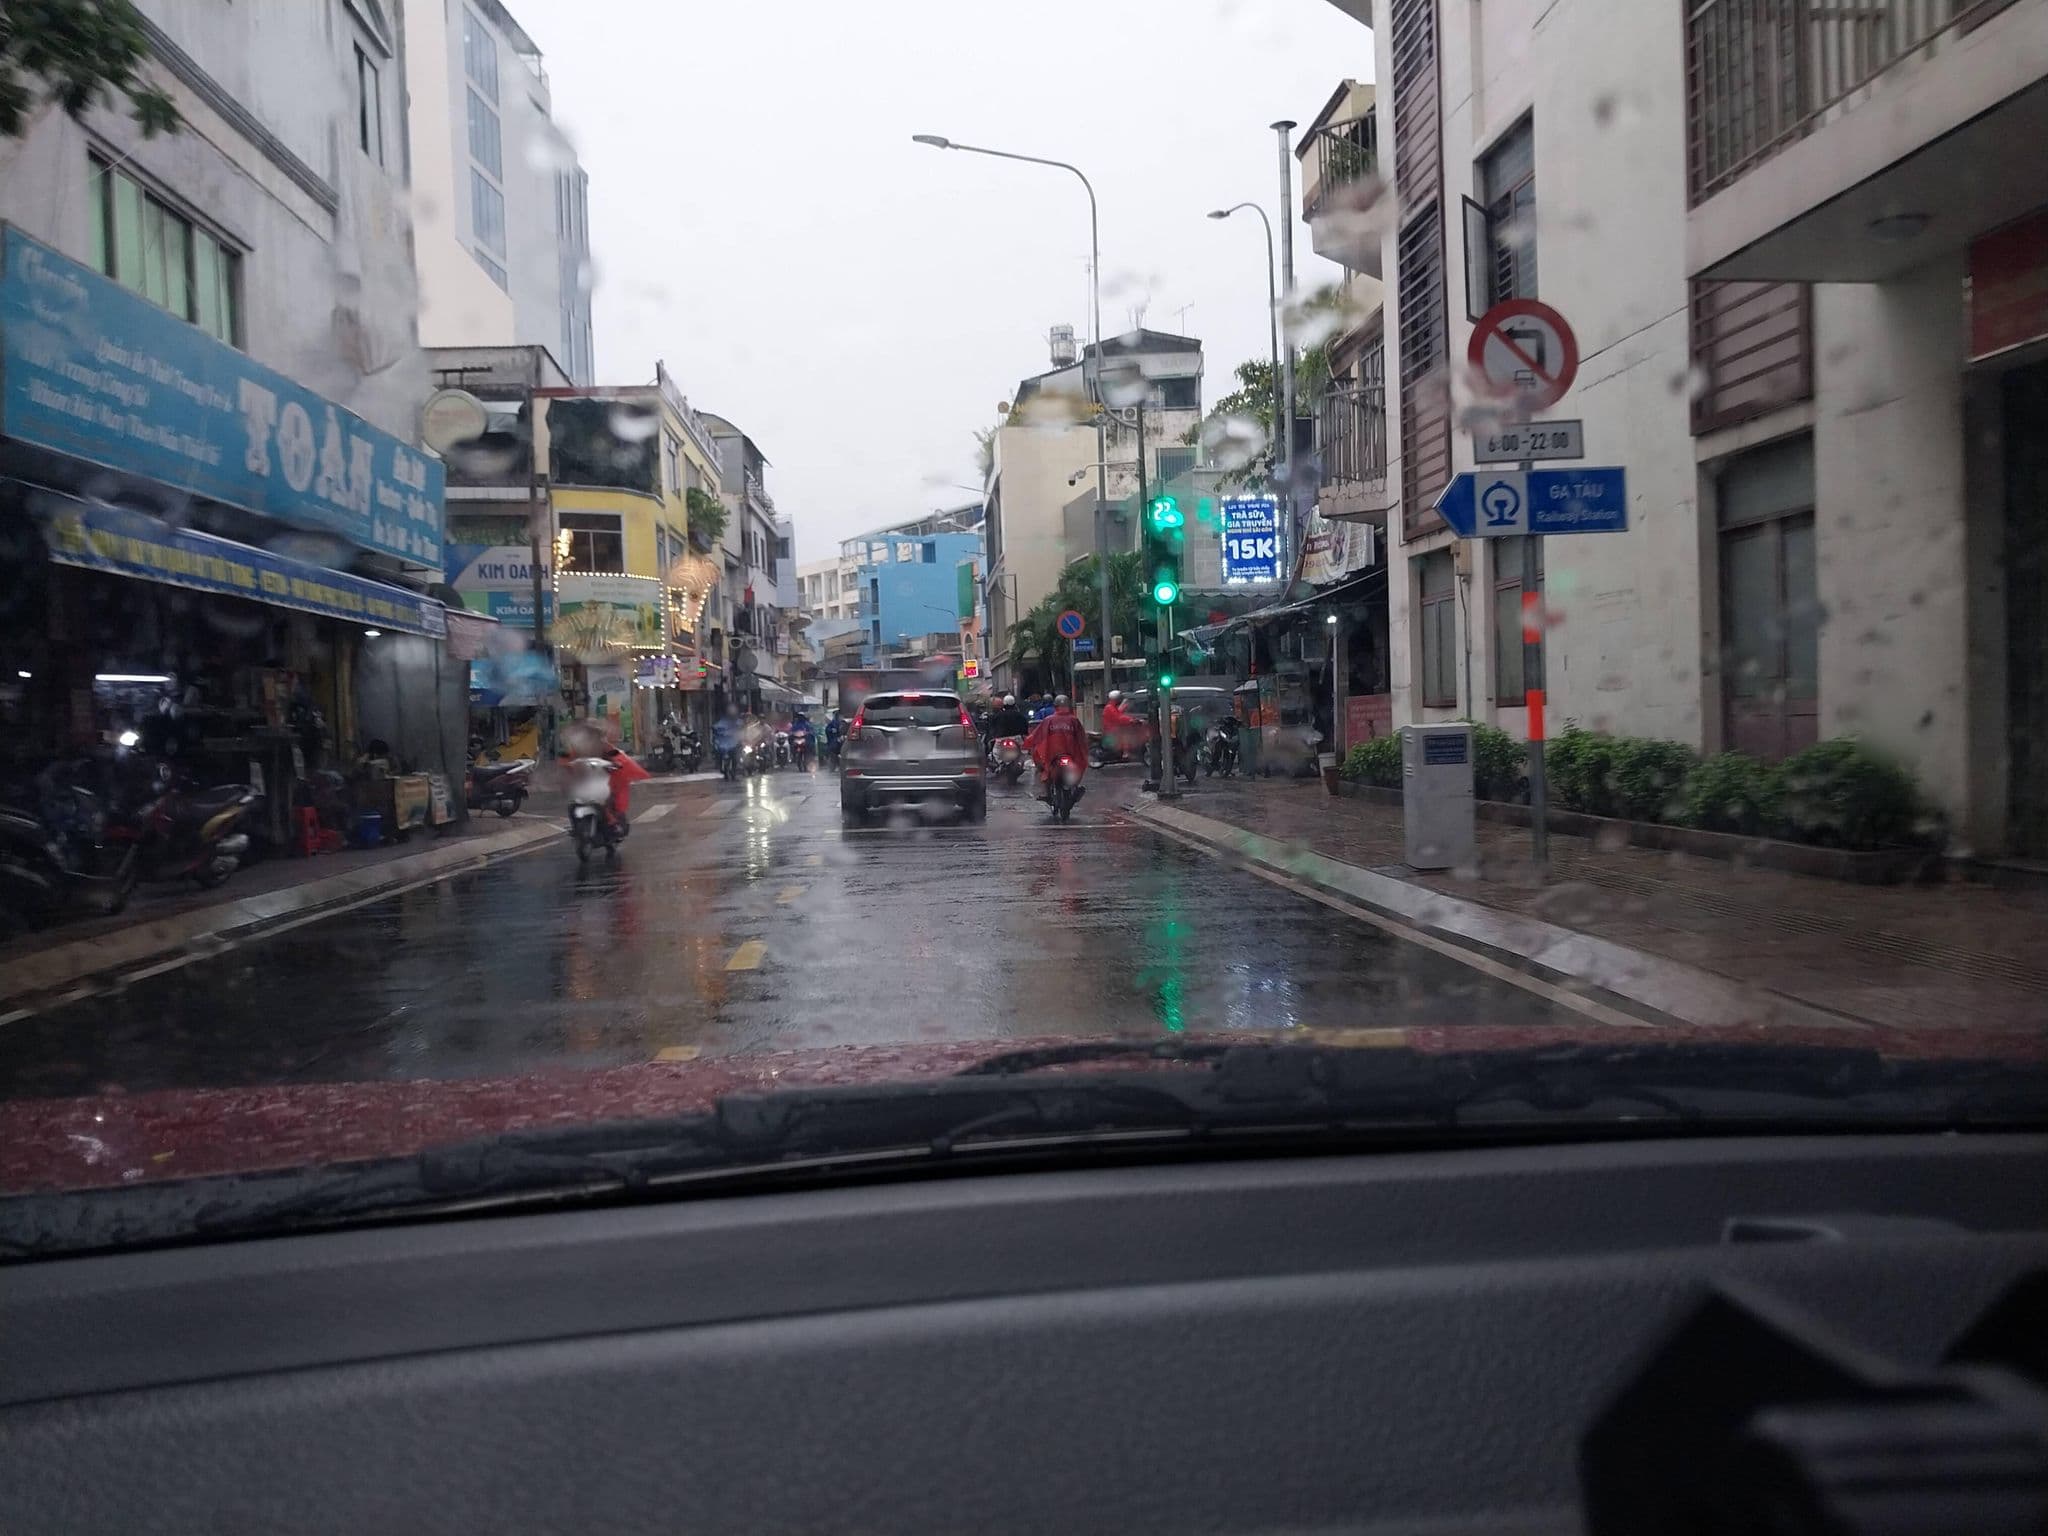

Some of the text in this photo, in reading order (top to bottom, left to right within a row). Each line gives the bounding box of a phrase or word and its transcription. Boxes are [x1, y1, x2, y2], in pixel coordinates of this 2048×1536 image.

[1550, 484, 1568, 499] GA
[1228, 538, 1274, 560] 15K
[478, 564, 504, 579] KIM
[496, 606, 552, 616] KIM OAH
